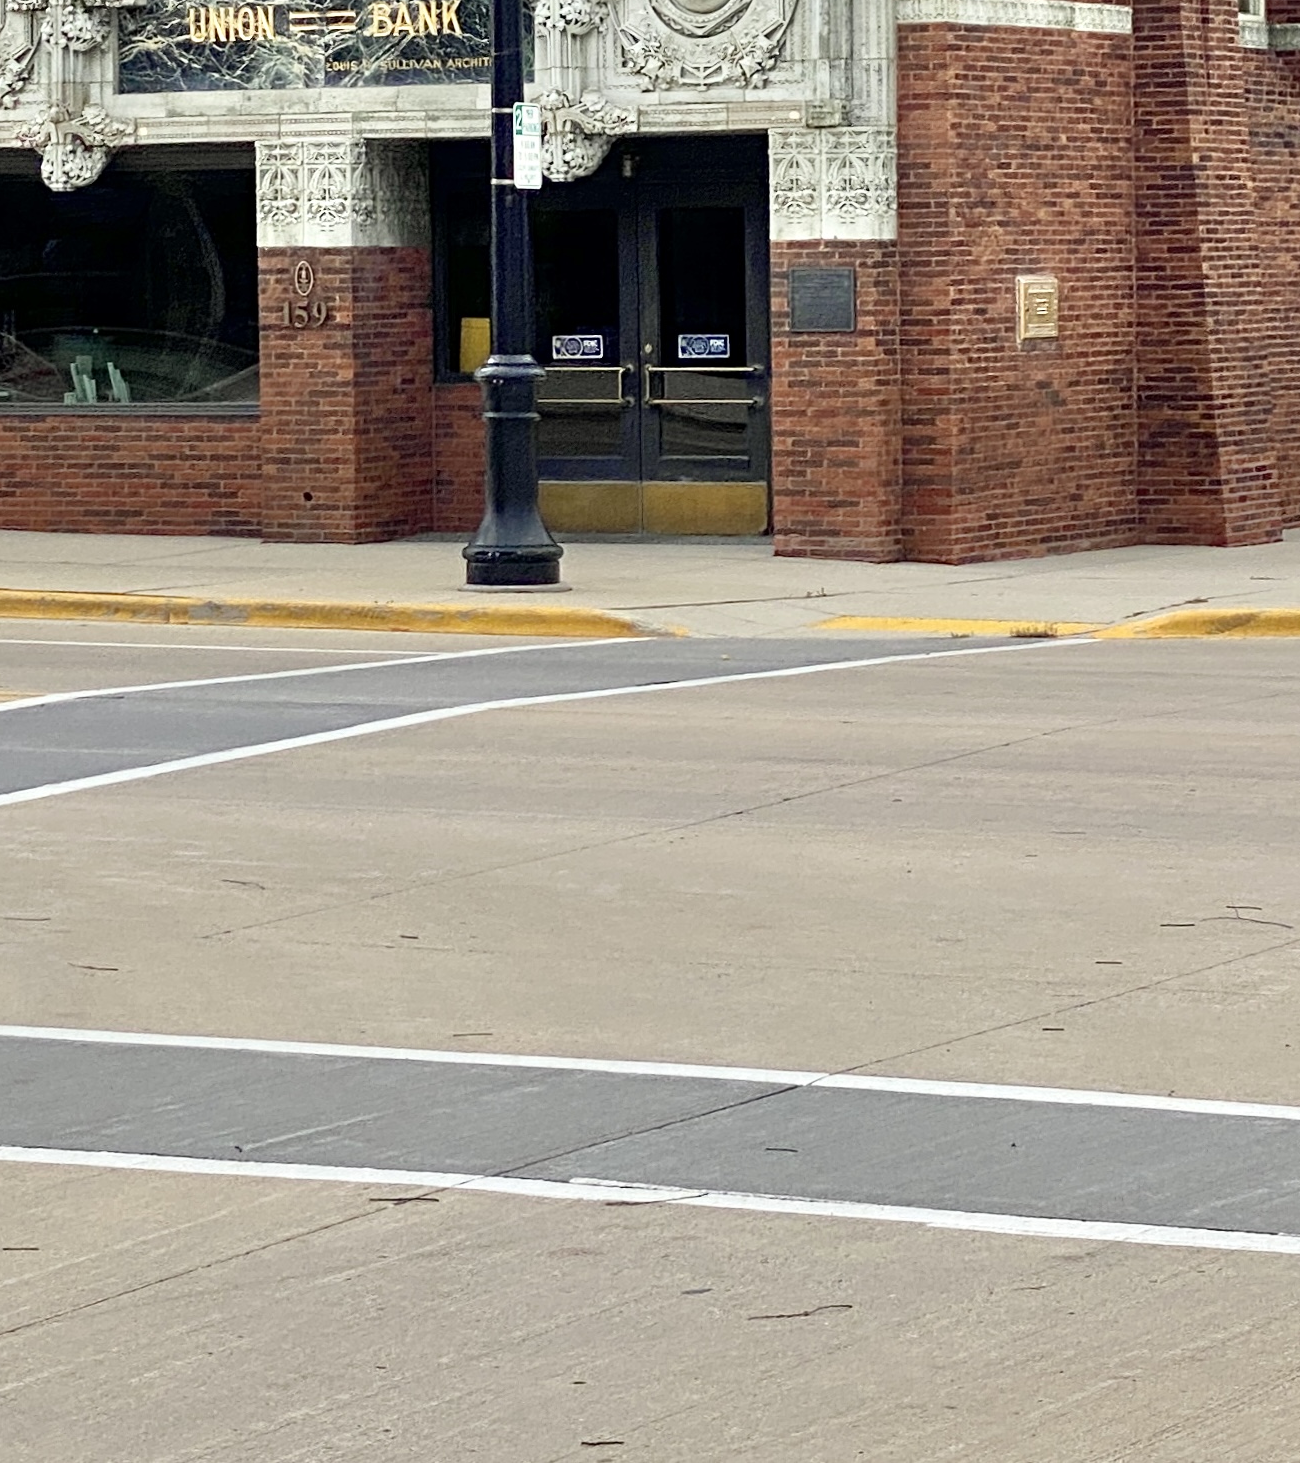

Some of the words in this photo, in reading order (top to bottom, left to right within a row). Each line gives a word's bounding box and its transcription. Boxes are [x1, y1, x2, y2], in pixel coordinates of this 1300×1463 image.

[189, 5, 276, 43] UNION
[326, 60, 359, 72] LOUIS
[379, 57, 441, 72] SULLIVAN
[446, 57, 492, 68] ARCHIT
[515, 108, 522, 131] 2
[283, 301, 327, 328] 159
